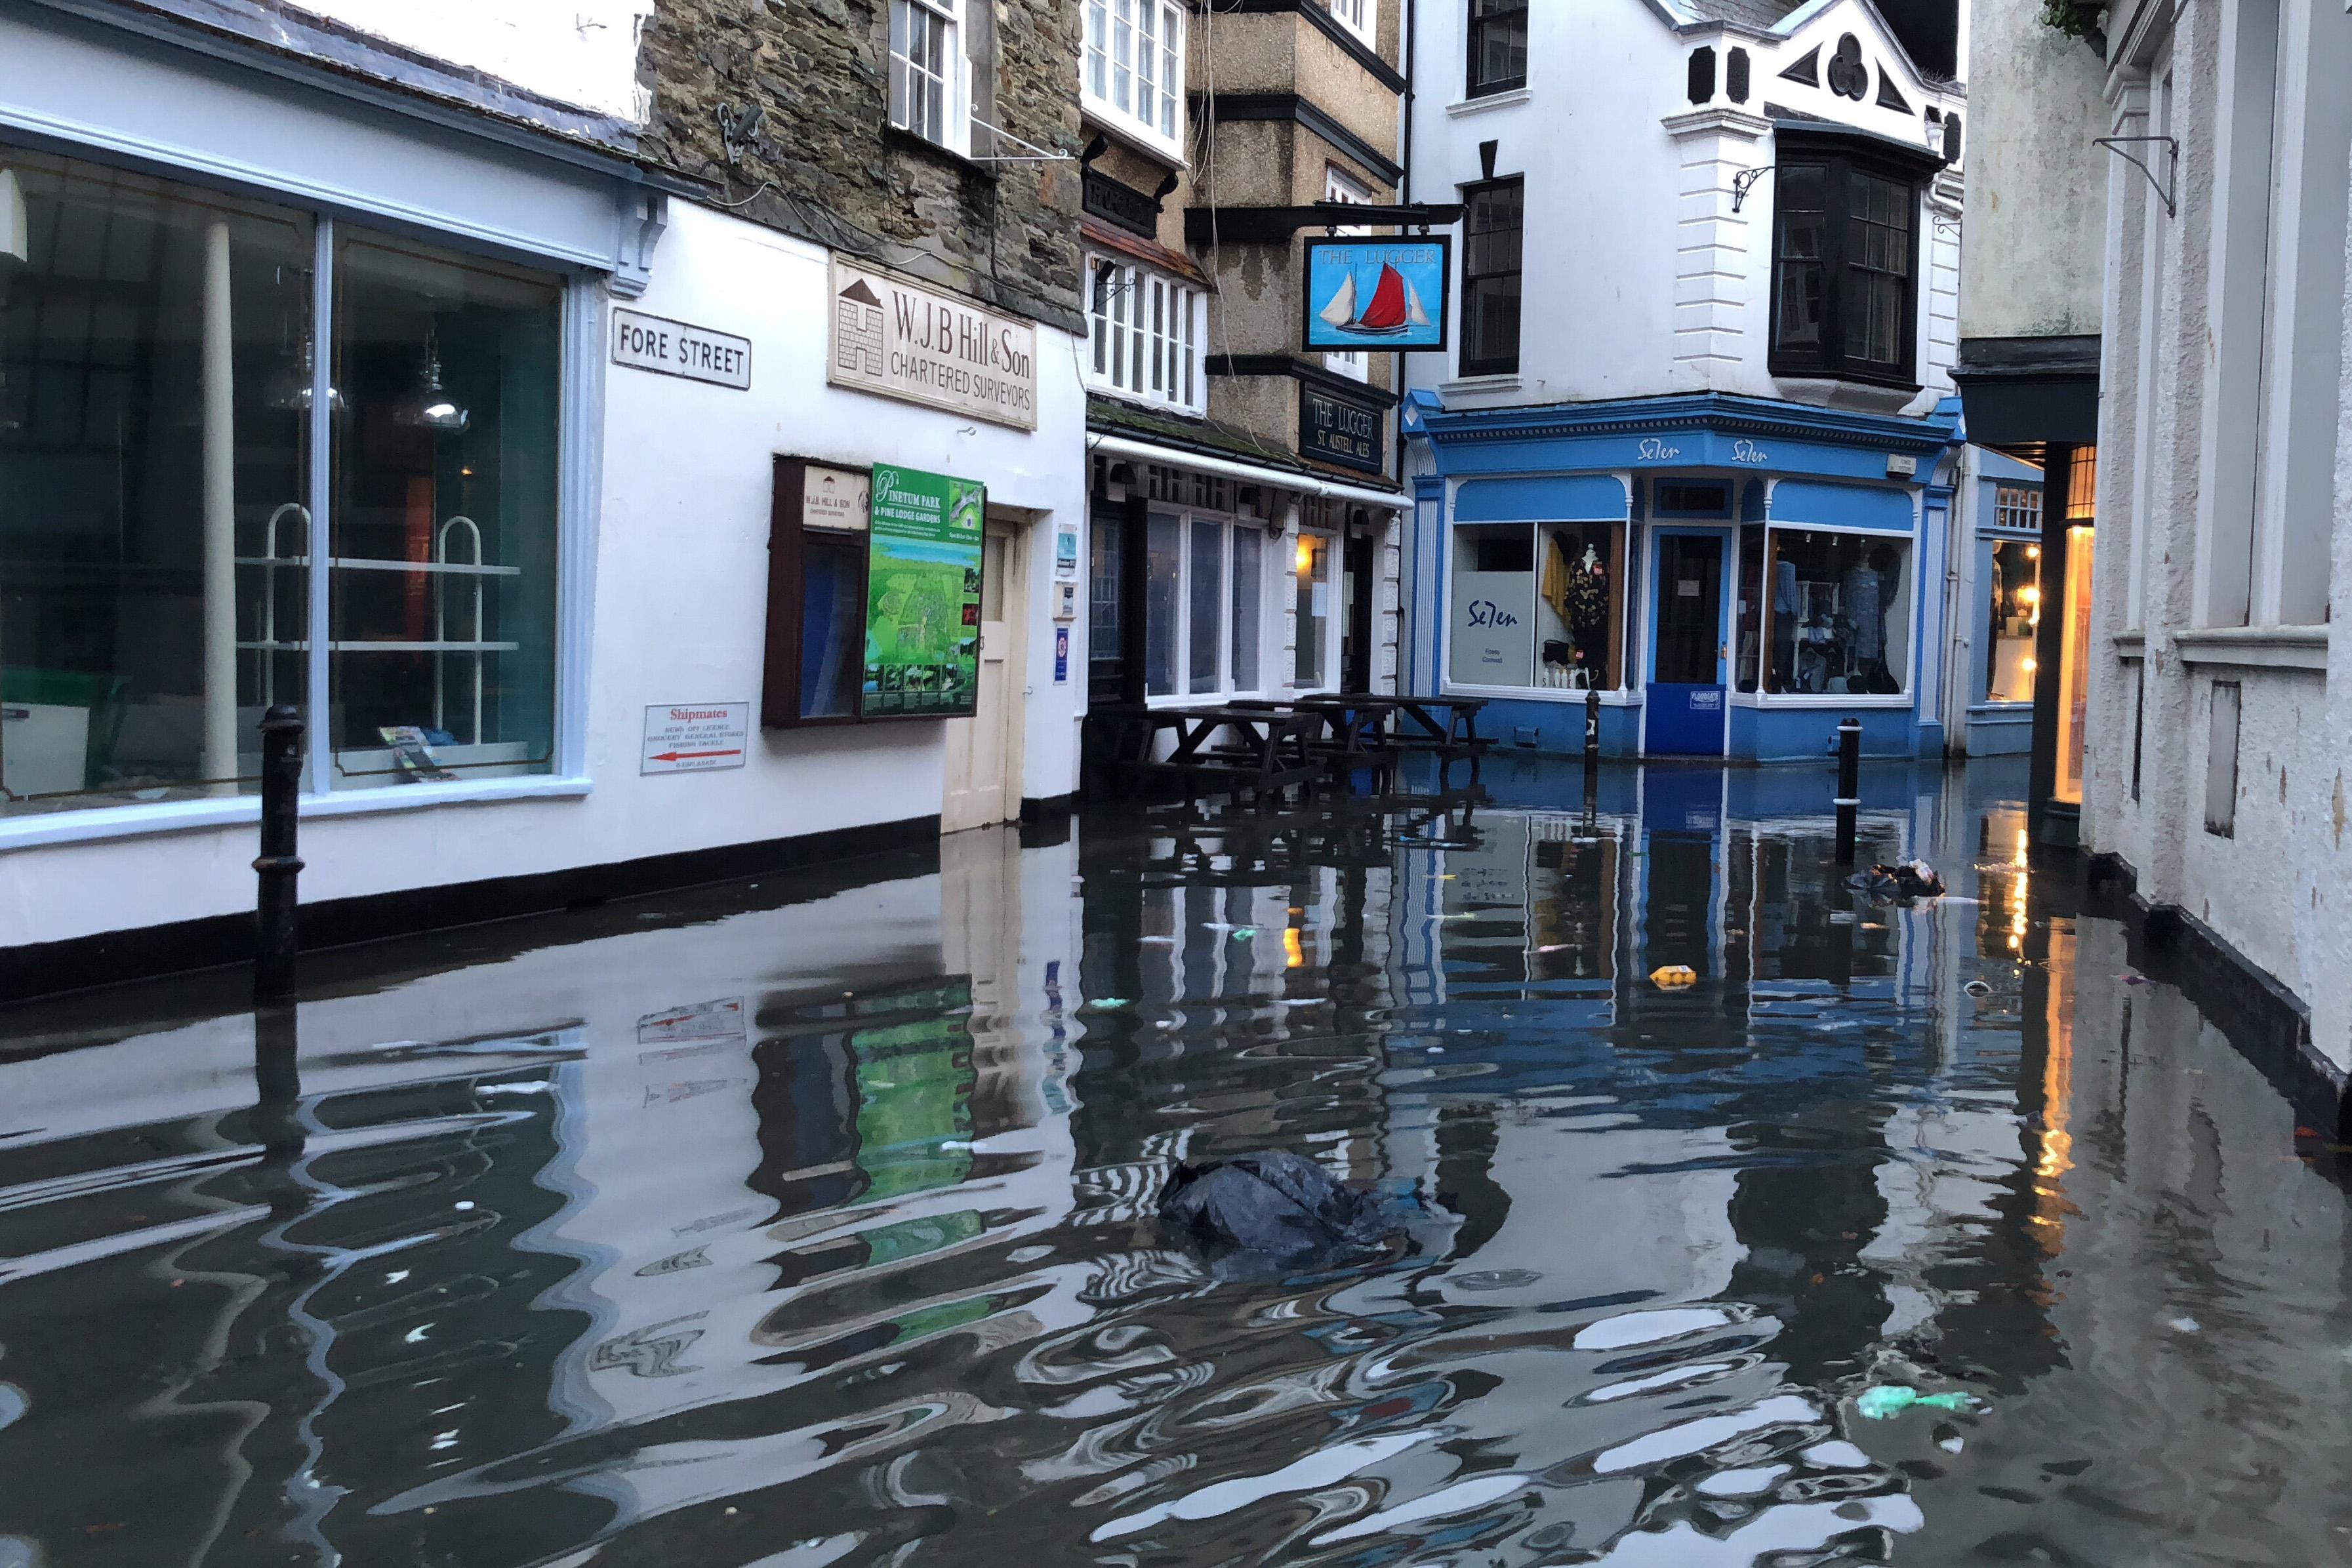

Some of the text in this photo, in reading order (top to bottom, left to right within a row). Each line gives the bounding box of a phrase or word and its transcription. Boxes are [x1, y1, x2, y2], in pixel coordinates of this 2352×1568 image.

[1318, 249, 1437, 264] THE LUGGER
[620, 324, 744, 375] FORE STREET
[959, 313, 989, 367] Hill
[990, 338, 1000, 365] &
[1002, 329, 1030, 379] Son
[891, 352, 1030, 411] CHARTERED SURVEYORS
[1312, 398, 1375, 441] THE LUGGER
[1318, 429, 1369, 458] ST AUSTELL ALES
[895, 508, 914, 520] LODGE
[916, 512, 941, 524] GARDENS
[922, 495, 941, 509] PARK
[670, 708, 727, 723] Shipmates
